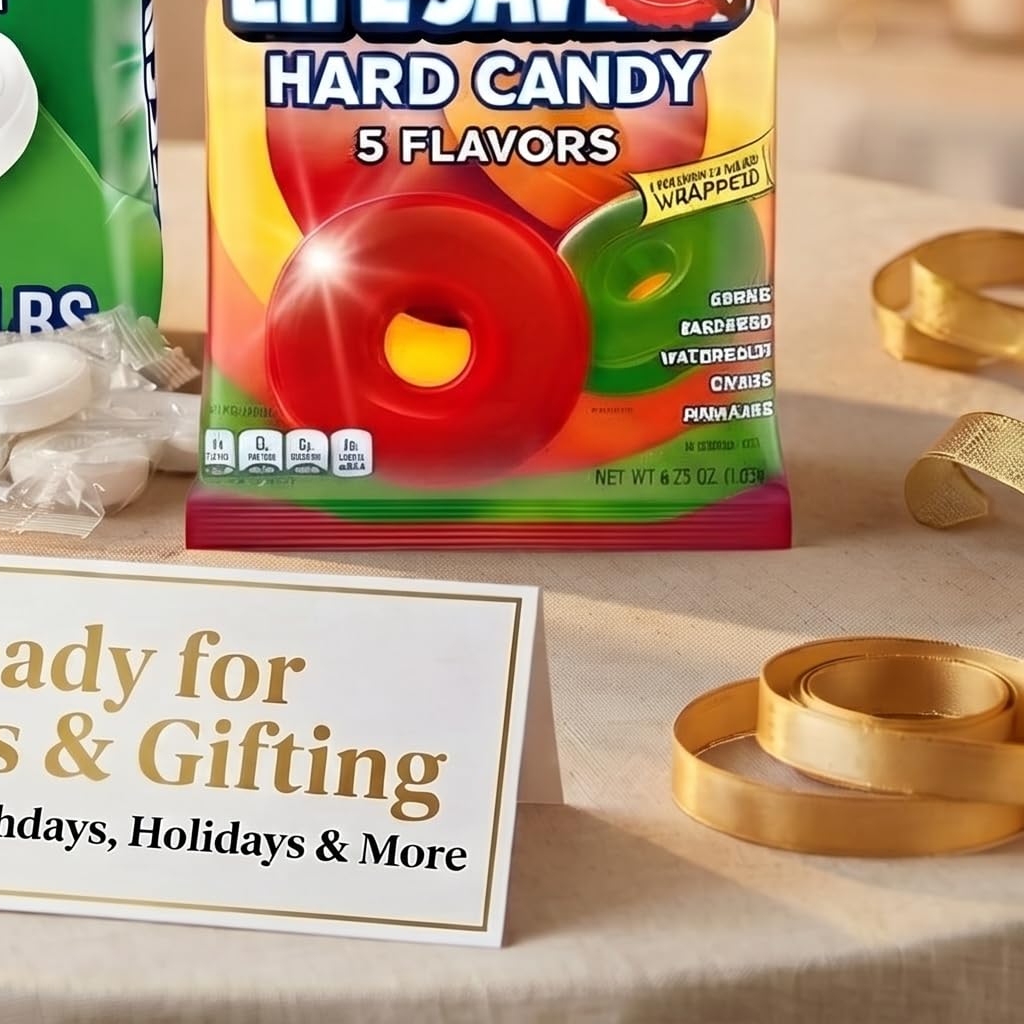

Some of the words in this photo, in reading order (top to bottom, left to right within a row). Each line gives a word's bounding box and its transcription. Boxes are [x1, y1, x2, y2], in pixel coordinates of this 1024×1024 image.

[268, 53, 455, 106] HARD
[477, 53, 705, 106] CANDY
[357, 128, 385, 160] 5
[401, 127, 618, 162] FLAVORS
[595, 469, 625, 485] NET
[632, 469, 655, 485] WT
[696, 469, 717, 485] OZ
[173, 631, 307, 705] for
[43, 712, 112, 783] &
[138, 718, 448, 823] Gifting
[127, 816, 306, 866] Holidays
[315, 831, 349, 863] &
[359, 833, 468, 873] More
